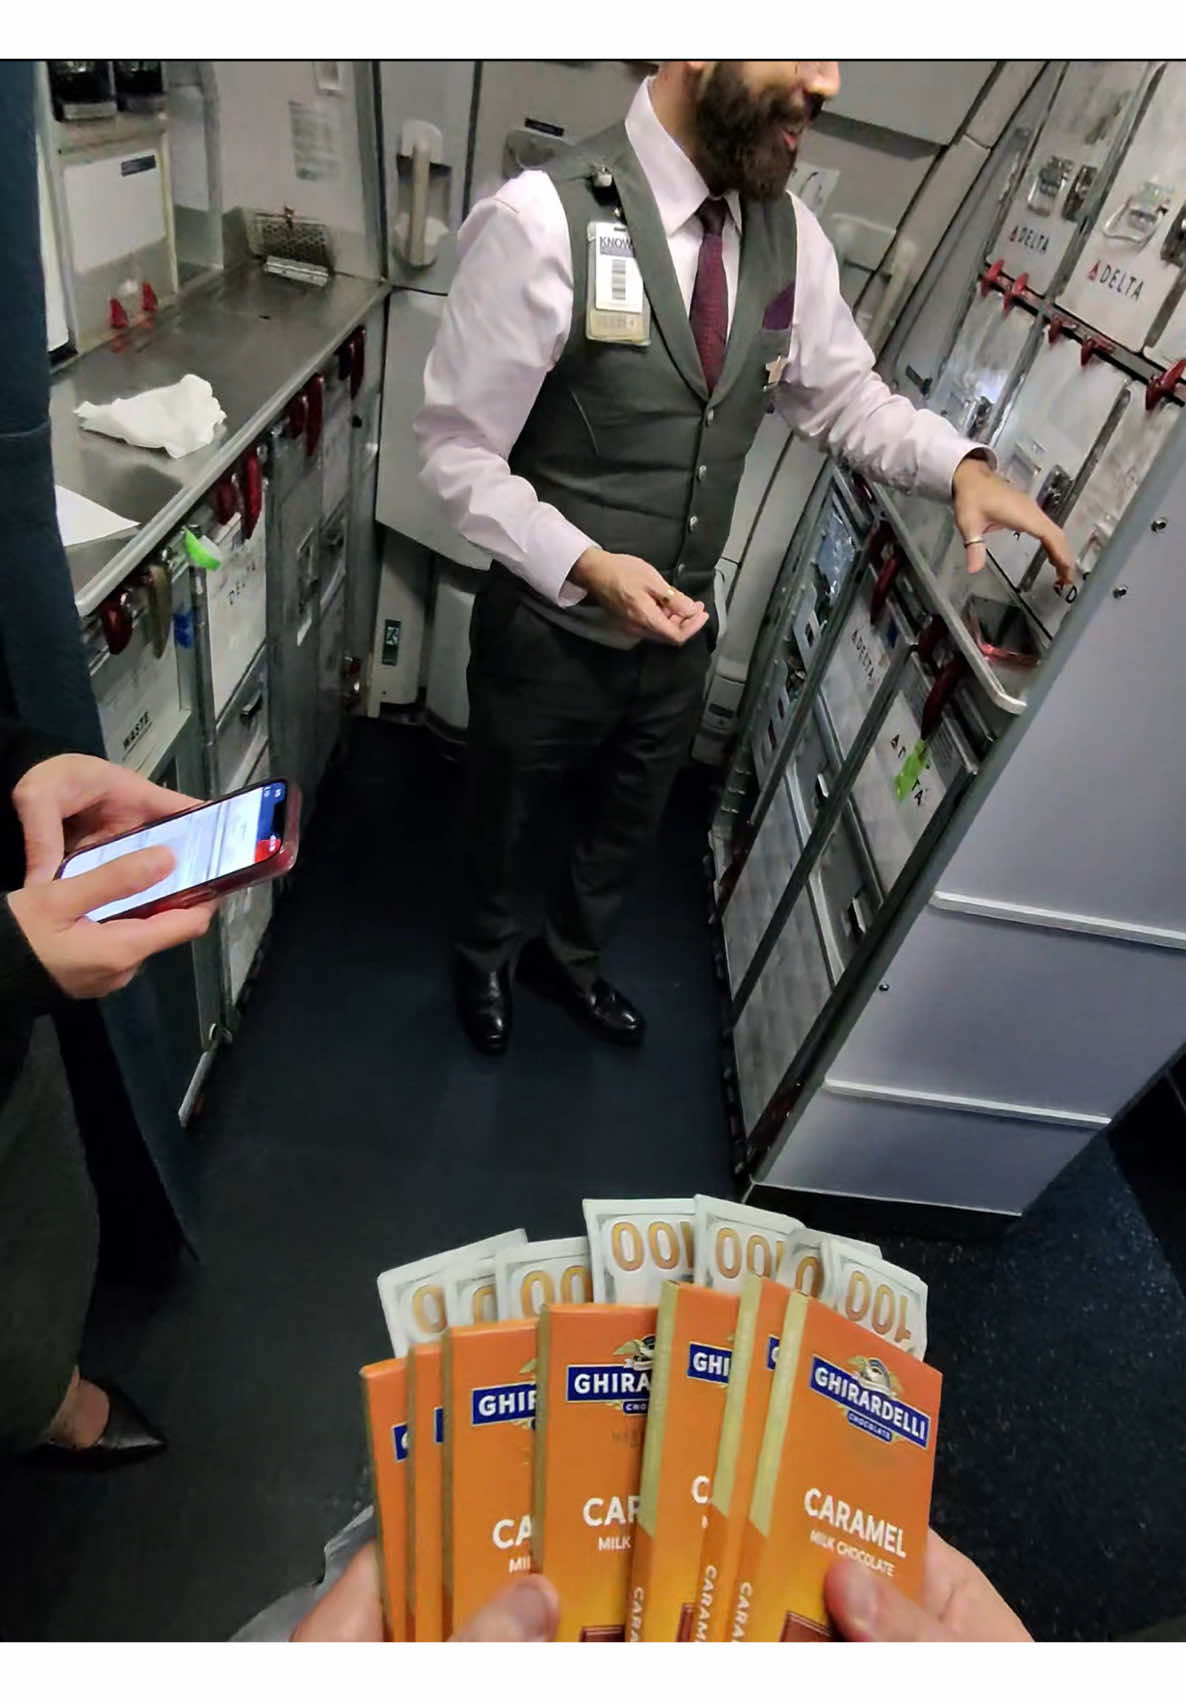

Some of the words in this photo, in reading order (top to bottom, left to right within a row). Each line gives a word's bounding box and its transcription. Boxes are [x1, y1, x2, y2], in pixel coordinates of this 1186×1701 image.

[1017, 226, 1050, 253] DELTA
[1100, 264, 1144, 301] DELTA
[692, 1352, 731, 1377] GHI
[574, 1373, 650, 1394] GHIRA
[814, 1367, 926, 1440] GHIRARDELLI
[804, 1487, 907, 1558] CARAMEL
[598, 1536, 632, 1550] MILK
[810, 1529, 836, 1552] MILK
